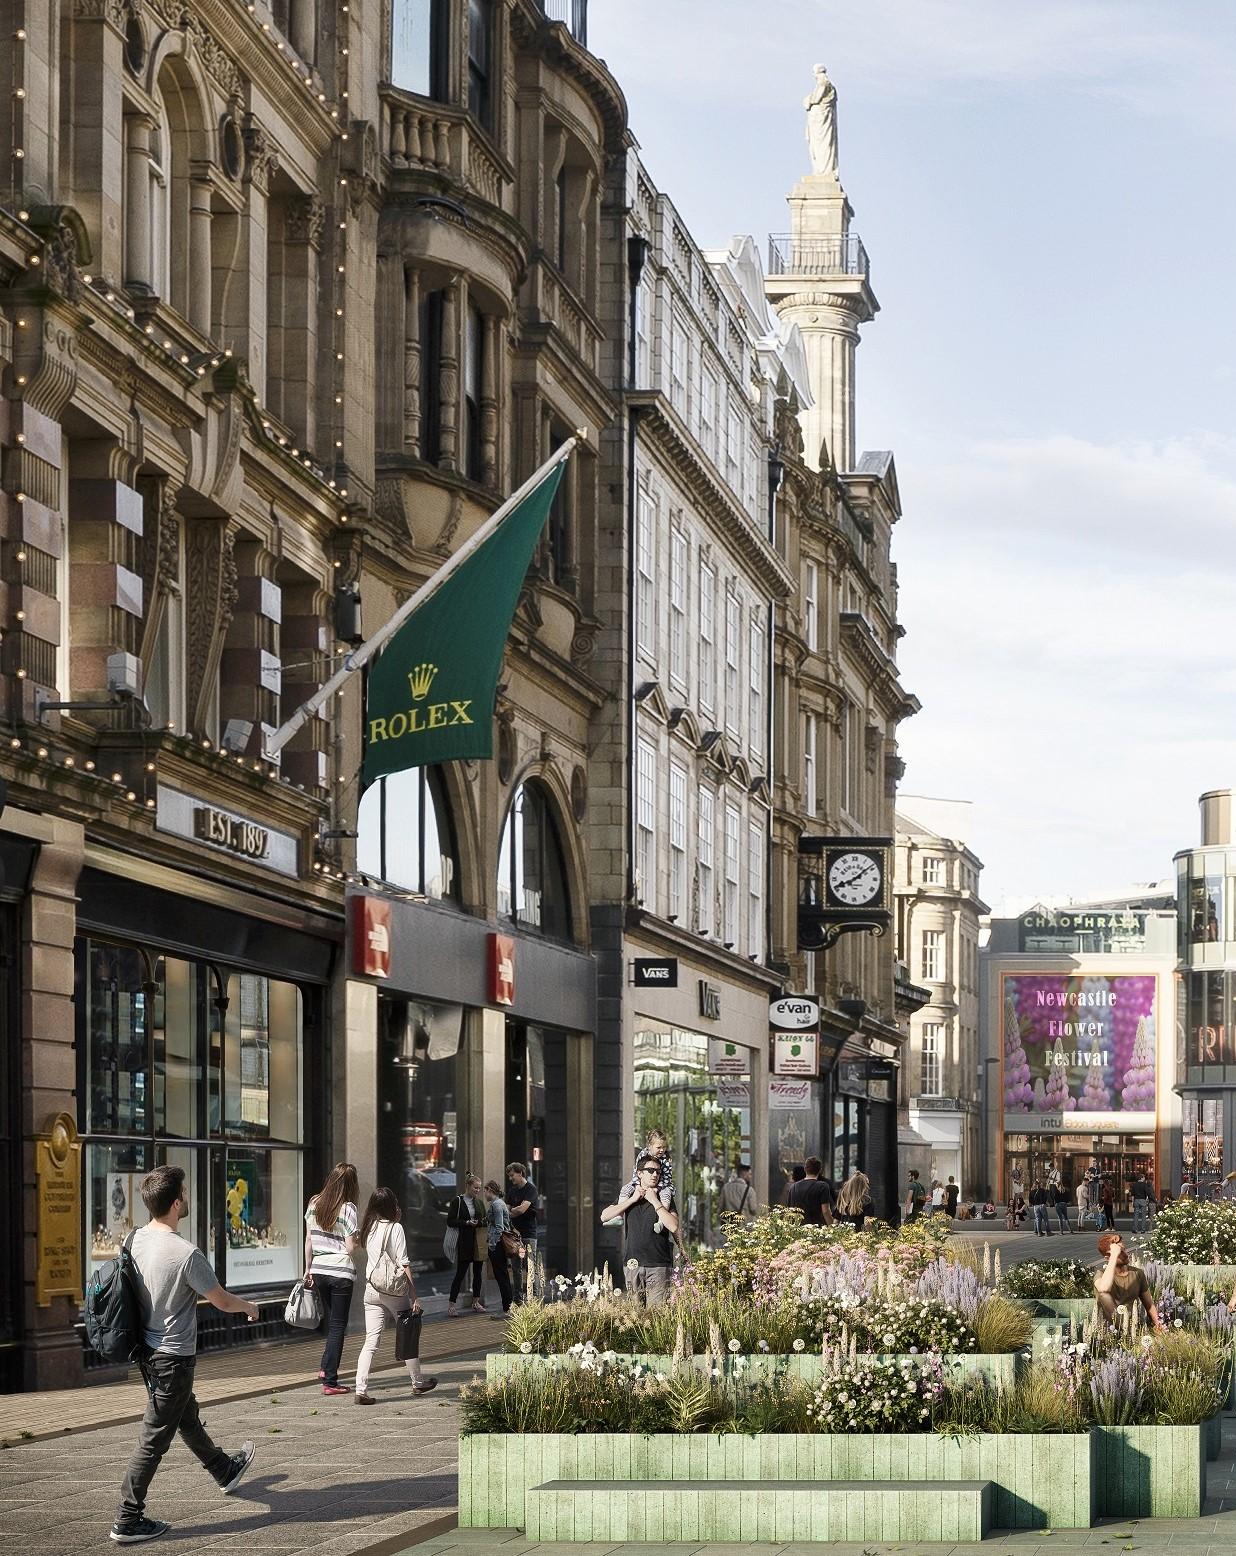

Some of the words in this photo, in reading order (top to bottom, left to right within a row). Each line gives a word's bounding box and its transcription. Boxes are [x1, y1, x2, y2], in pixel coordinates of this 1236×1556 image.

[369, 700, 475, 744] ROLEX
[208, 808, 238, 848] EST.
[642, 967, 670, 979] VANS
[1035, 990, 1118, 1007] Newcastle
[1048, 1020, 1105, 1037] Flower
[1044, 1050, 1109, 1067] Festival
[1040, 1118, 1062, 1129] intu
